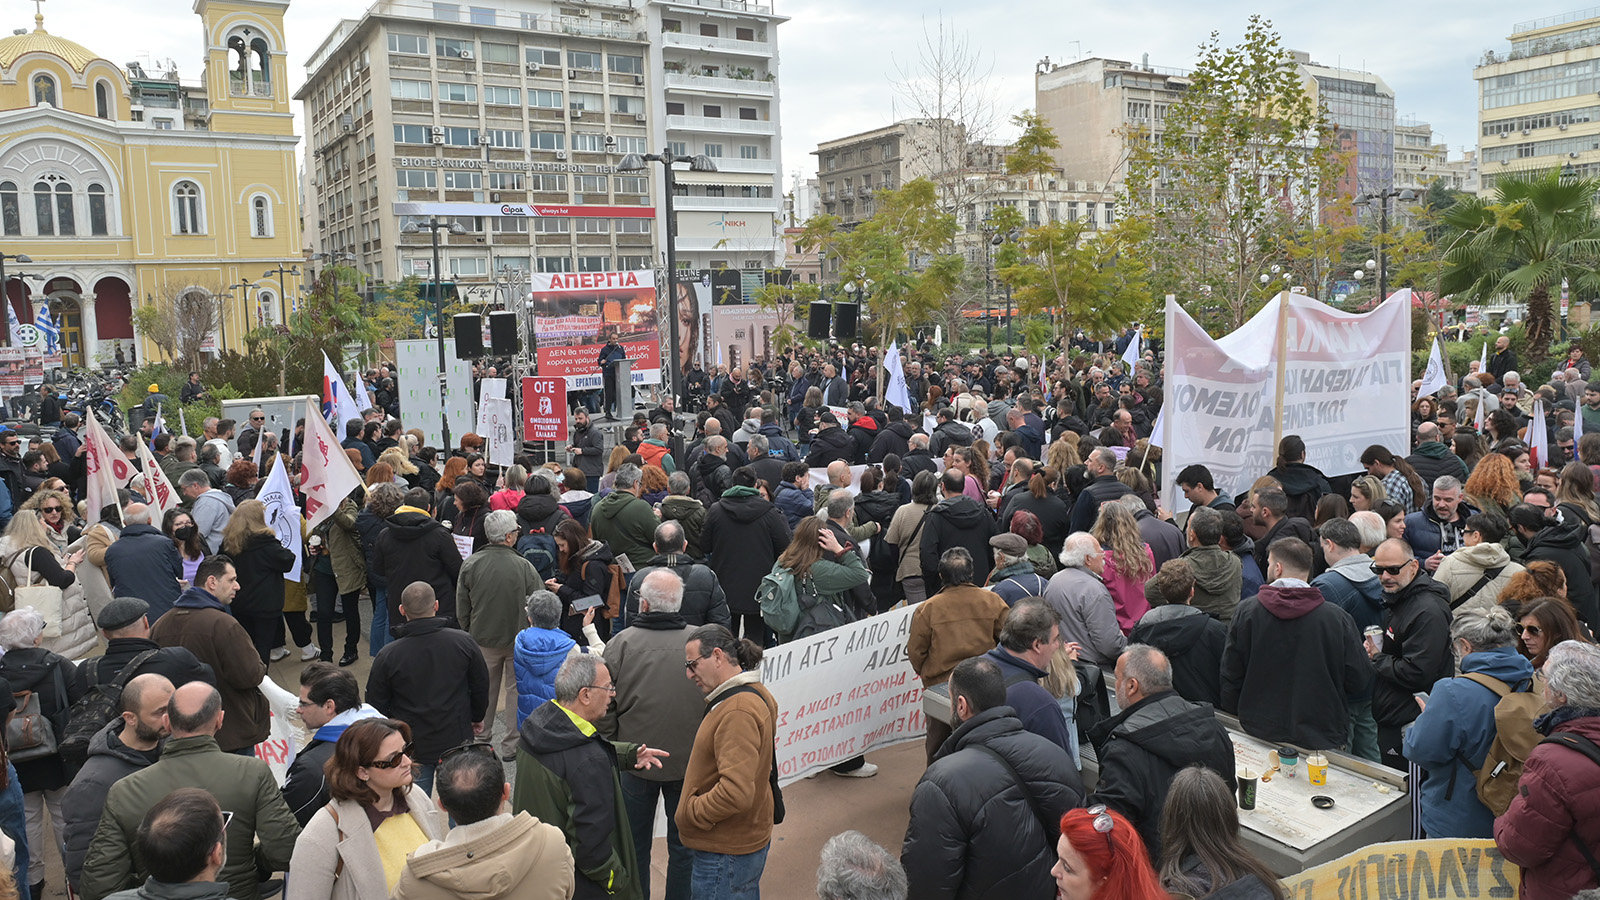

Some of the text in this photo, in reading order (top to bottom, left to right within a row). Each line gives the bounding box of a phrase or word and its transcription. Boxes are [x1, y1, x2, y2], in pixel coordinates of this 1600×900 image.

[401, 158, 483, 168] ΒΙΟΤΕΧΝΙΚΟΝ
[541, 207, 559, 215] always
[549, 271, 639, 290] ΑΠΕΡΓΙΑ
[549, 349, 567, 357] ΔΕΝ
[568, 348, 577, 356] θα
[578, 347, 602, 356] παίζου
[637, 344, 650, 352] μας
[547, 357, 573, 367] κορόνα
[565, 365, 571, 373] &
[572, 365, 589, 374] τους
[575, 376, 602, 387] ΕΡΓΑΤΙΚΟ
[534, 381, 555, 393] ΟΓΕ
